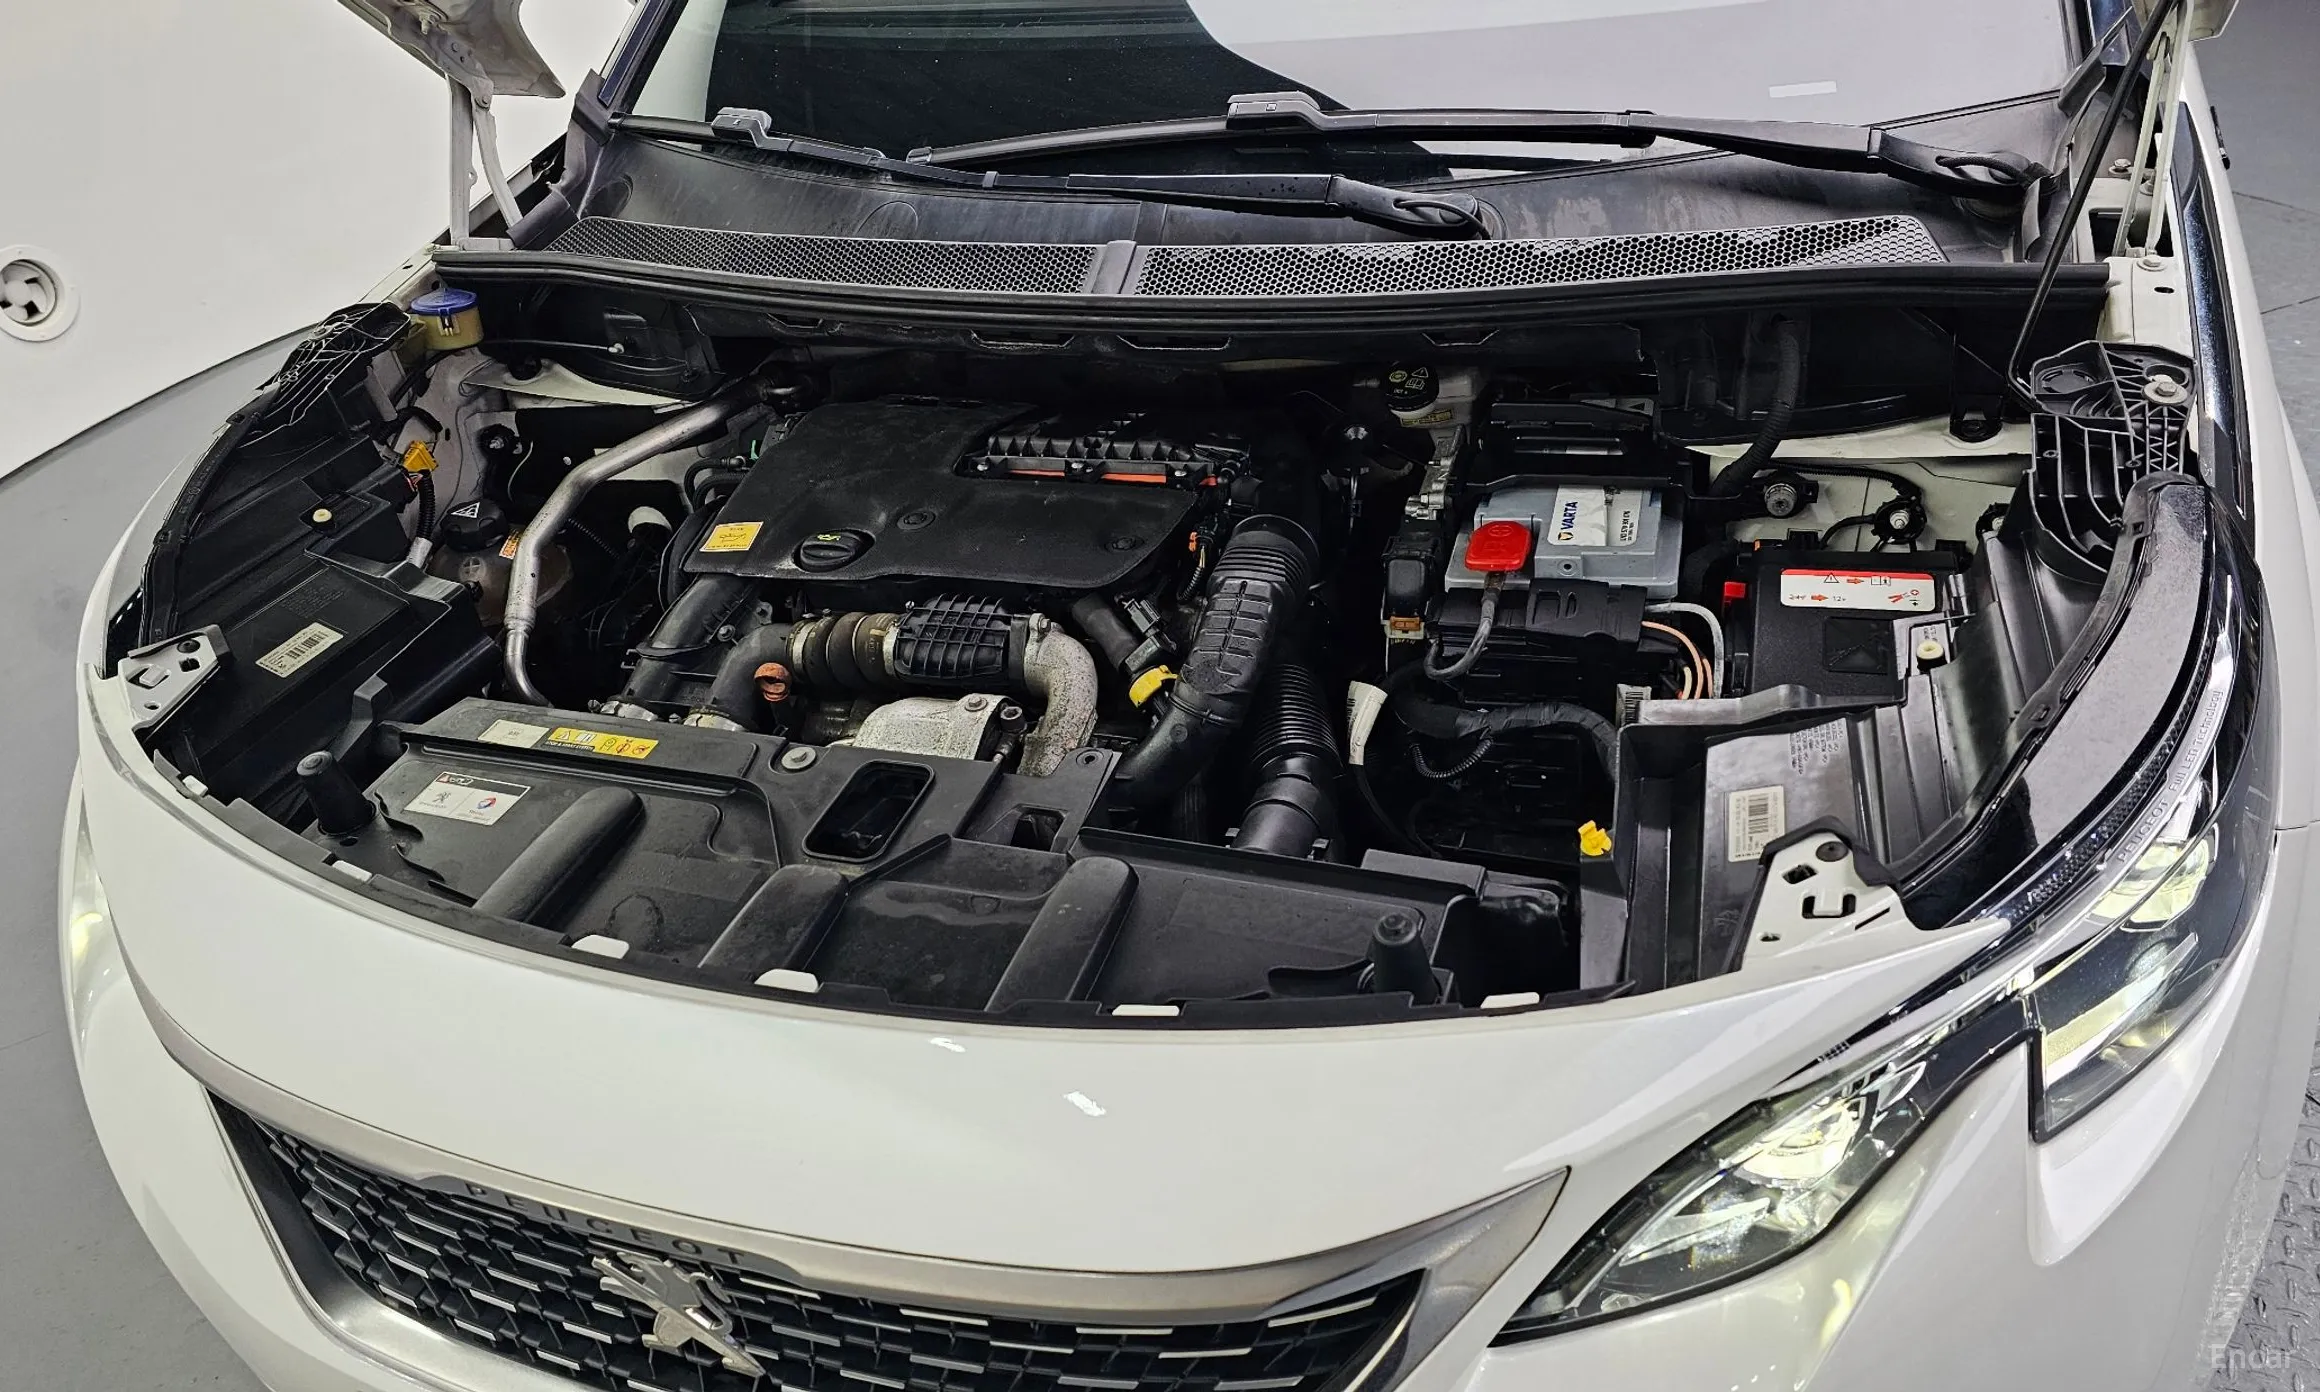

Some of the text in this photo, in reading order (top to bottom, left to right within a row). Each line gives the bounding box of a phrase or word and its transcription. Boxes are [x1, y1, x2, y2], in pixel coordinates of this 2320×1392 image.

[1560, 501, 1579, 530] VARTA
[2117, 799, 2171, 864] PEUGEOT
[2181, 748, 2199, 770] LED
[2192, 690, 2224, 746] Technology
[464, 1182, 747, 1265] PEUGEOT
